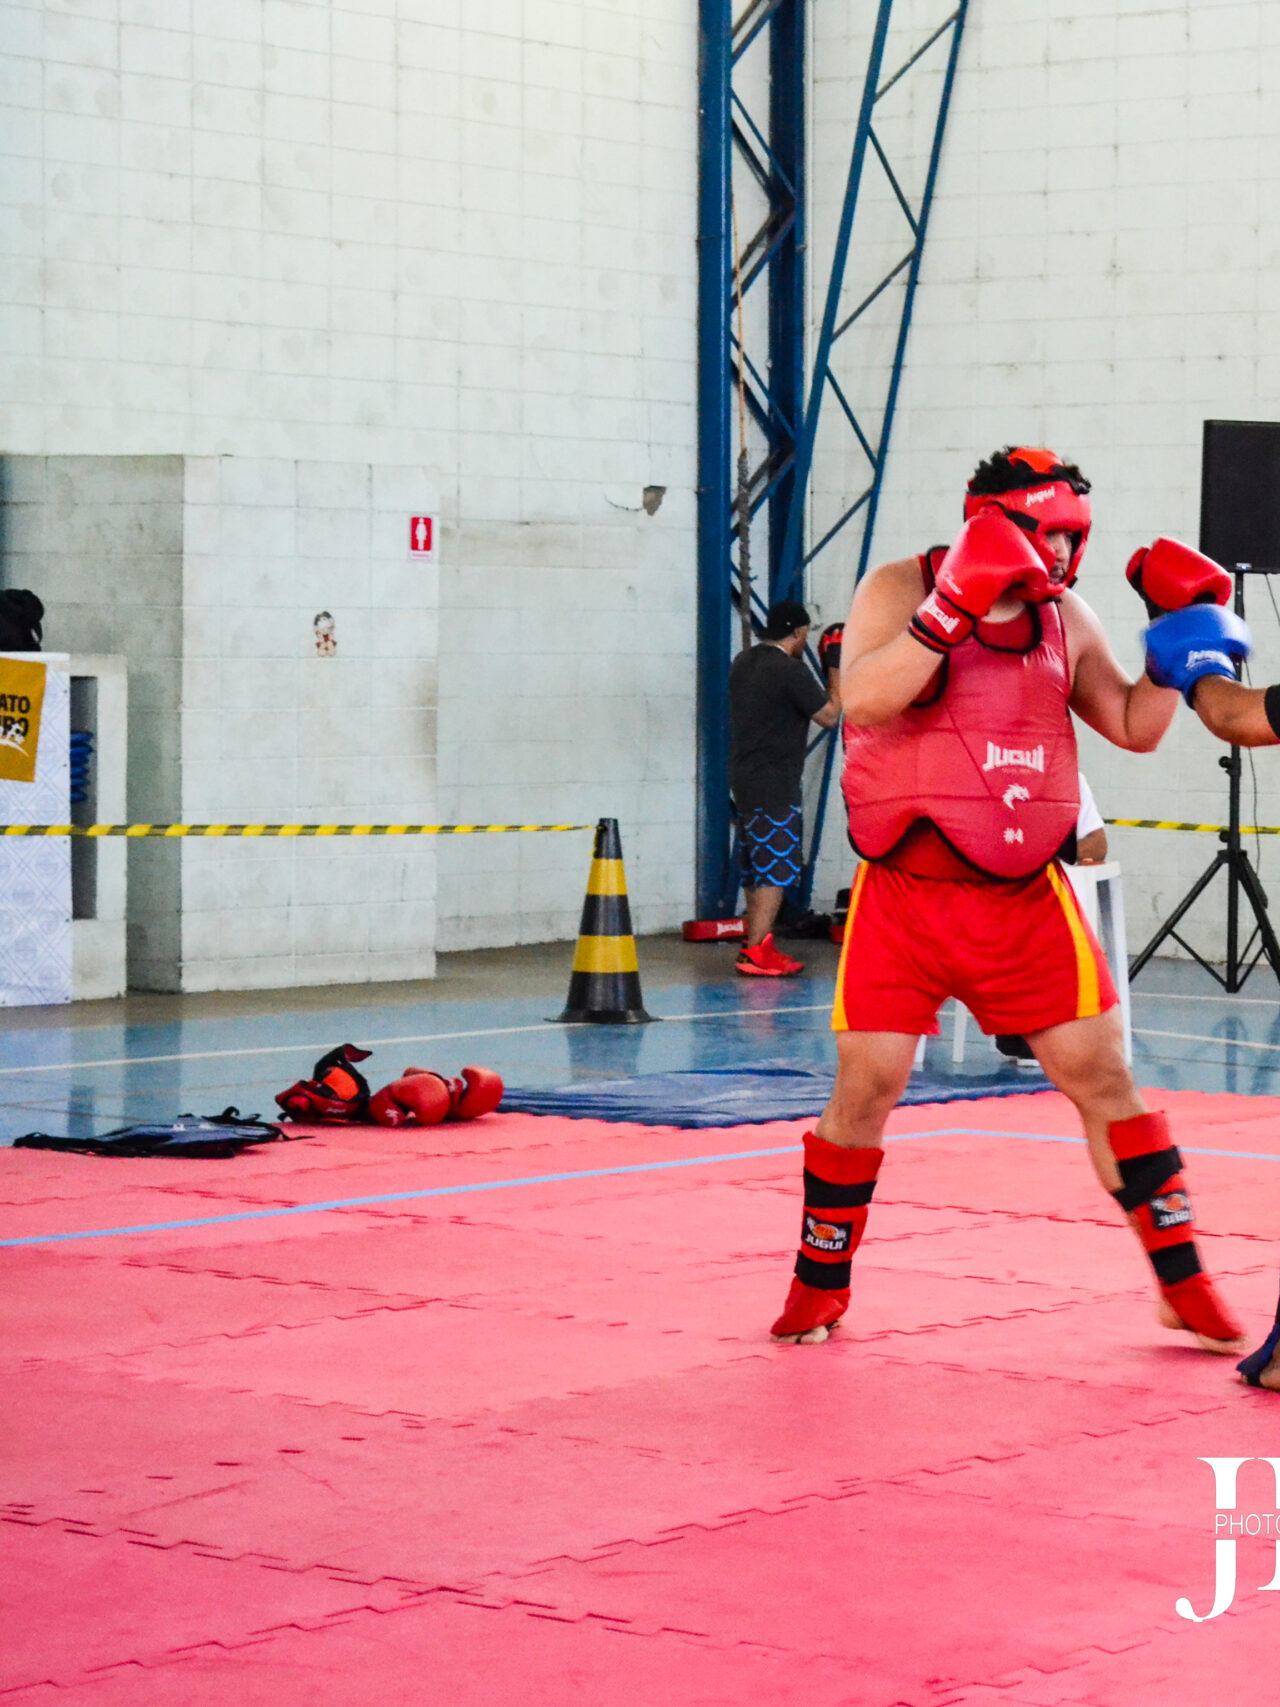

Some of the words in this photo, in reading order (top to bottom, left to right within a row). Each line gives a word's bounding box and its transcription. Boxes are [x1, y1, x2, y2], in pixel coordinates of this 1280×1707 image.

[982, 741, 1044, 773] JUGUI
[1003, 827, 1024, 844] #4
[805, 1233, 844, 1250] JUGUI
